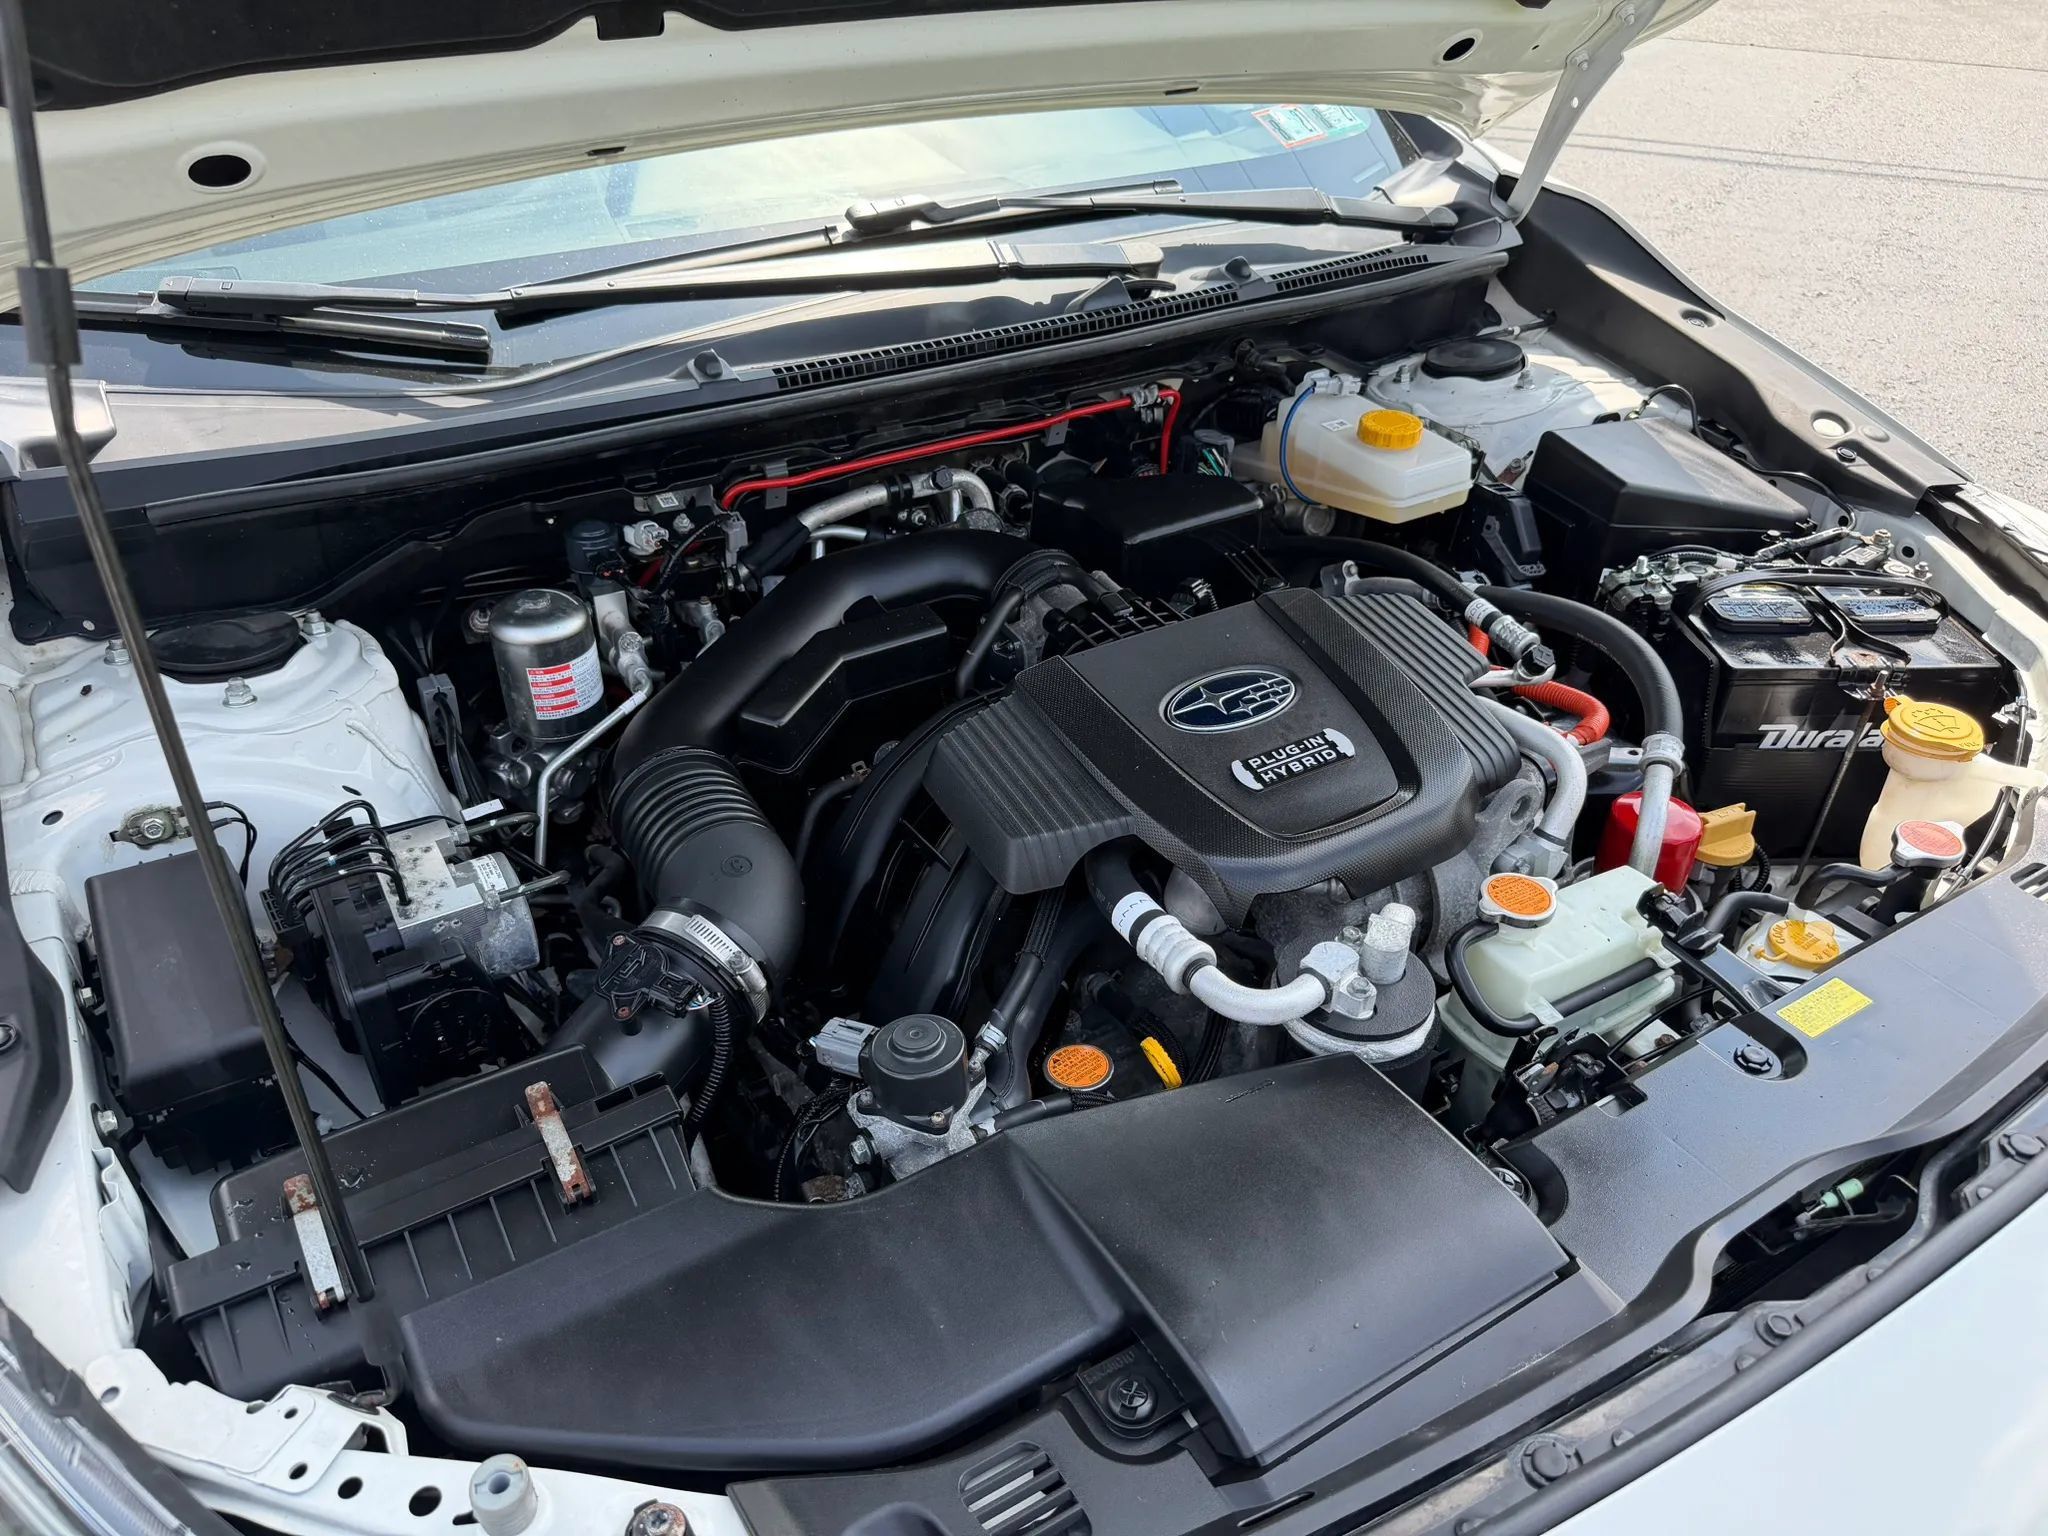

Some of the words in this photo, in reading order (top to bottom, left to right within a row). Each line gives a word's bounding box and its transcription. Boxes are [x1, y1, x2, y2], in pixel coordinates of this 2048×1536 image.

[1758, 722, 1885, 749] Durala
[1248, 736, 1325, 769] PLUG-IN
[1260, 749, 1337, 783] HYBRID
